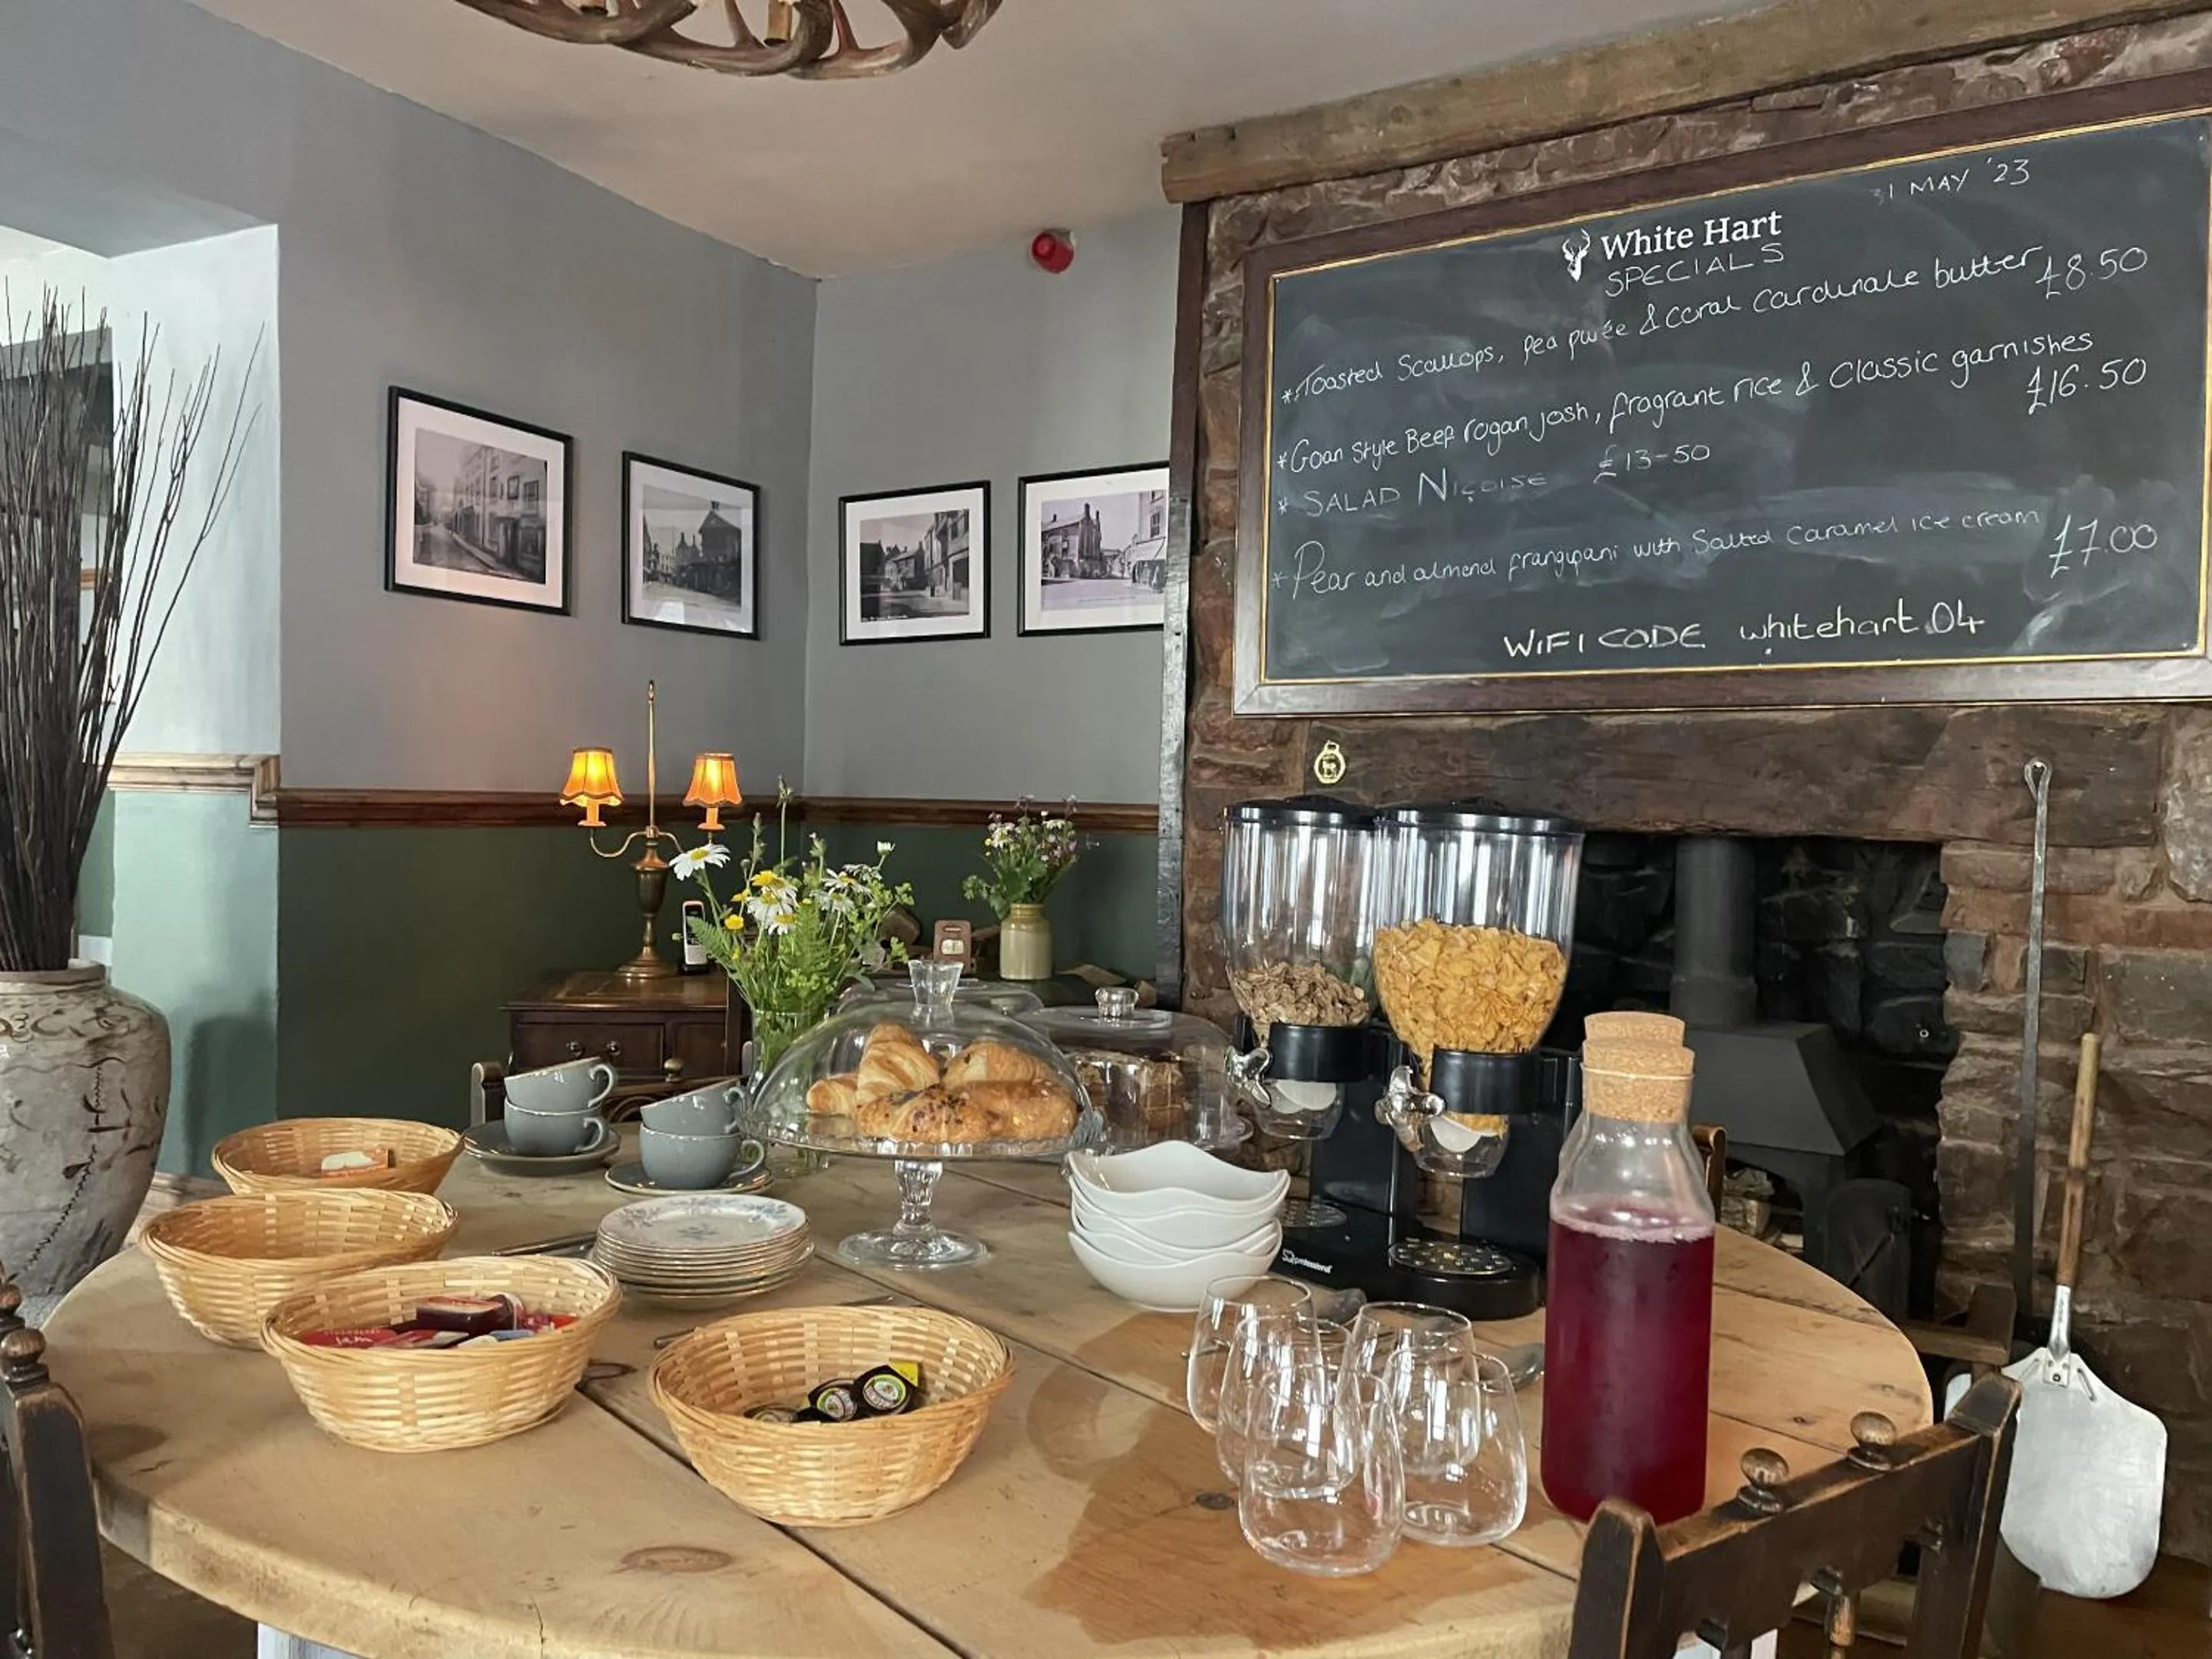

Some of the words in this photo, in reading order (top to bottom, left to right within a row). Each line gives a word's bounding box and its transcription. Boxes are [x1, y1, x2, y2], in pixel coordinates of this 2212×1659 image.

[1909, 168, 1969, 196] MAY
[1601, 225, 1694, 260] White
[1703, 210, 1782, 247] Hart
[1605, 243, 1784, 297] SPECIALS
[1294, 361, 1383, 402] Toasted
[1639, 303, 1660, 336] &
[1936, 245, 2044, 289] butter
[2035, 247, 2148, 300] £8.50
[1290, 439, 1343, 473] Goan
[1405, 425, 1455, 454] Beef
[1463, 416, 1528, 456] rogan
[1609, 386, 1726, 435] fragrant
[1734, 376, 1783, 402] rice
[1796, 361, 1820, 396] &
[1950, 332, 2094, 389] garnishes
[2027, 357, 2147, 416] £16.50
[1303, 487, 1401, 518] SALAD
[1293, 540, 1356, 600] Pear
[1364, 564, 1408, 588] and
[1412, 557, 1497, 582] almond
[1633, 538, 1681, 558] with
[2048, 513, 2158, 580] £7.00
[1598, 623, 1707, 650] CODE
